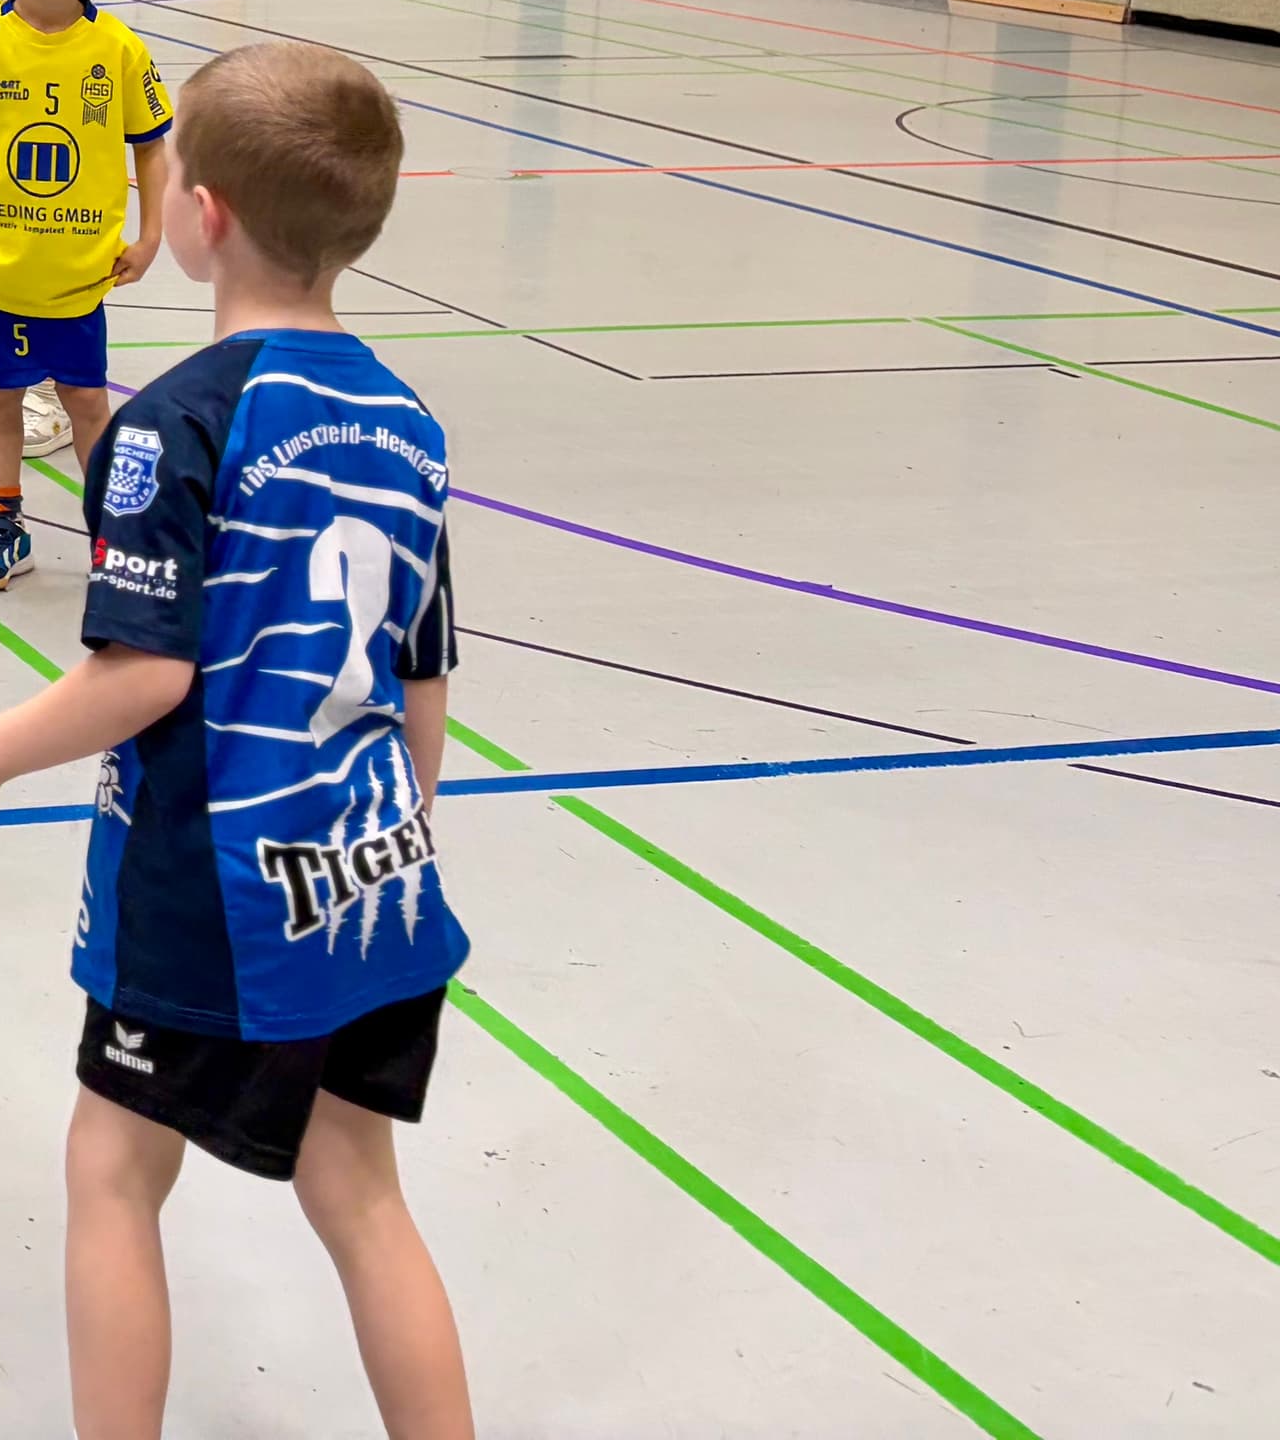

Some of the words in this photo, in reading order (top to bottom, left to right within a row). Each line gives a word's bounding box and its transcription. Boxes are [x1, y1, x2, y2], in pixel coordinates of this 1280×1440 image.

[45, 83, 60, 115] 5
[84, 82, 109, 97] HSG
[53, 208, 102, 223] GMBH
[13, 323, 30, 357] 5
[106, 1045, 153, 1074] erima
